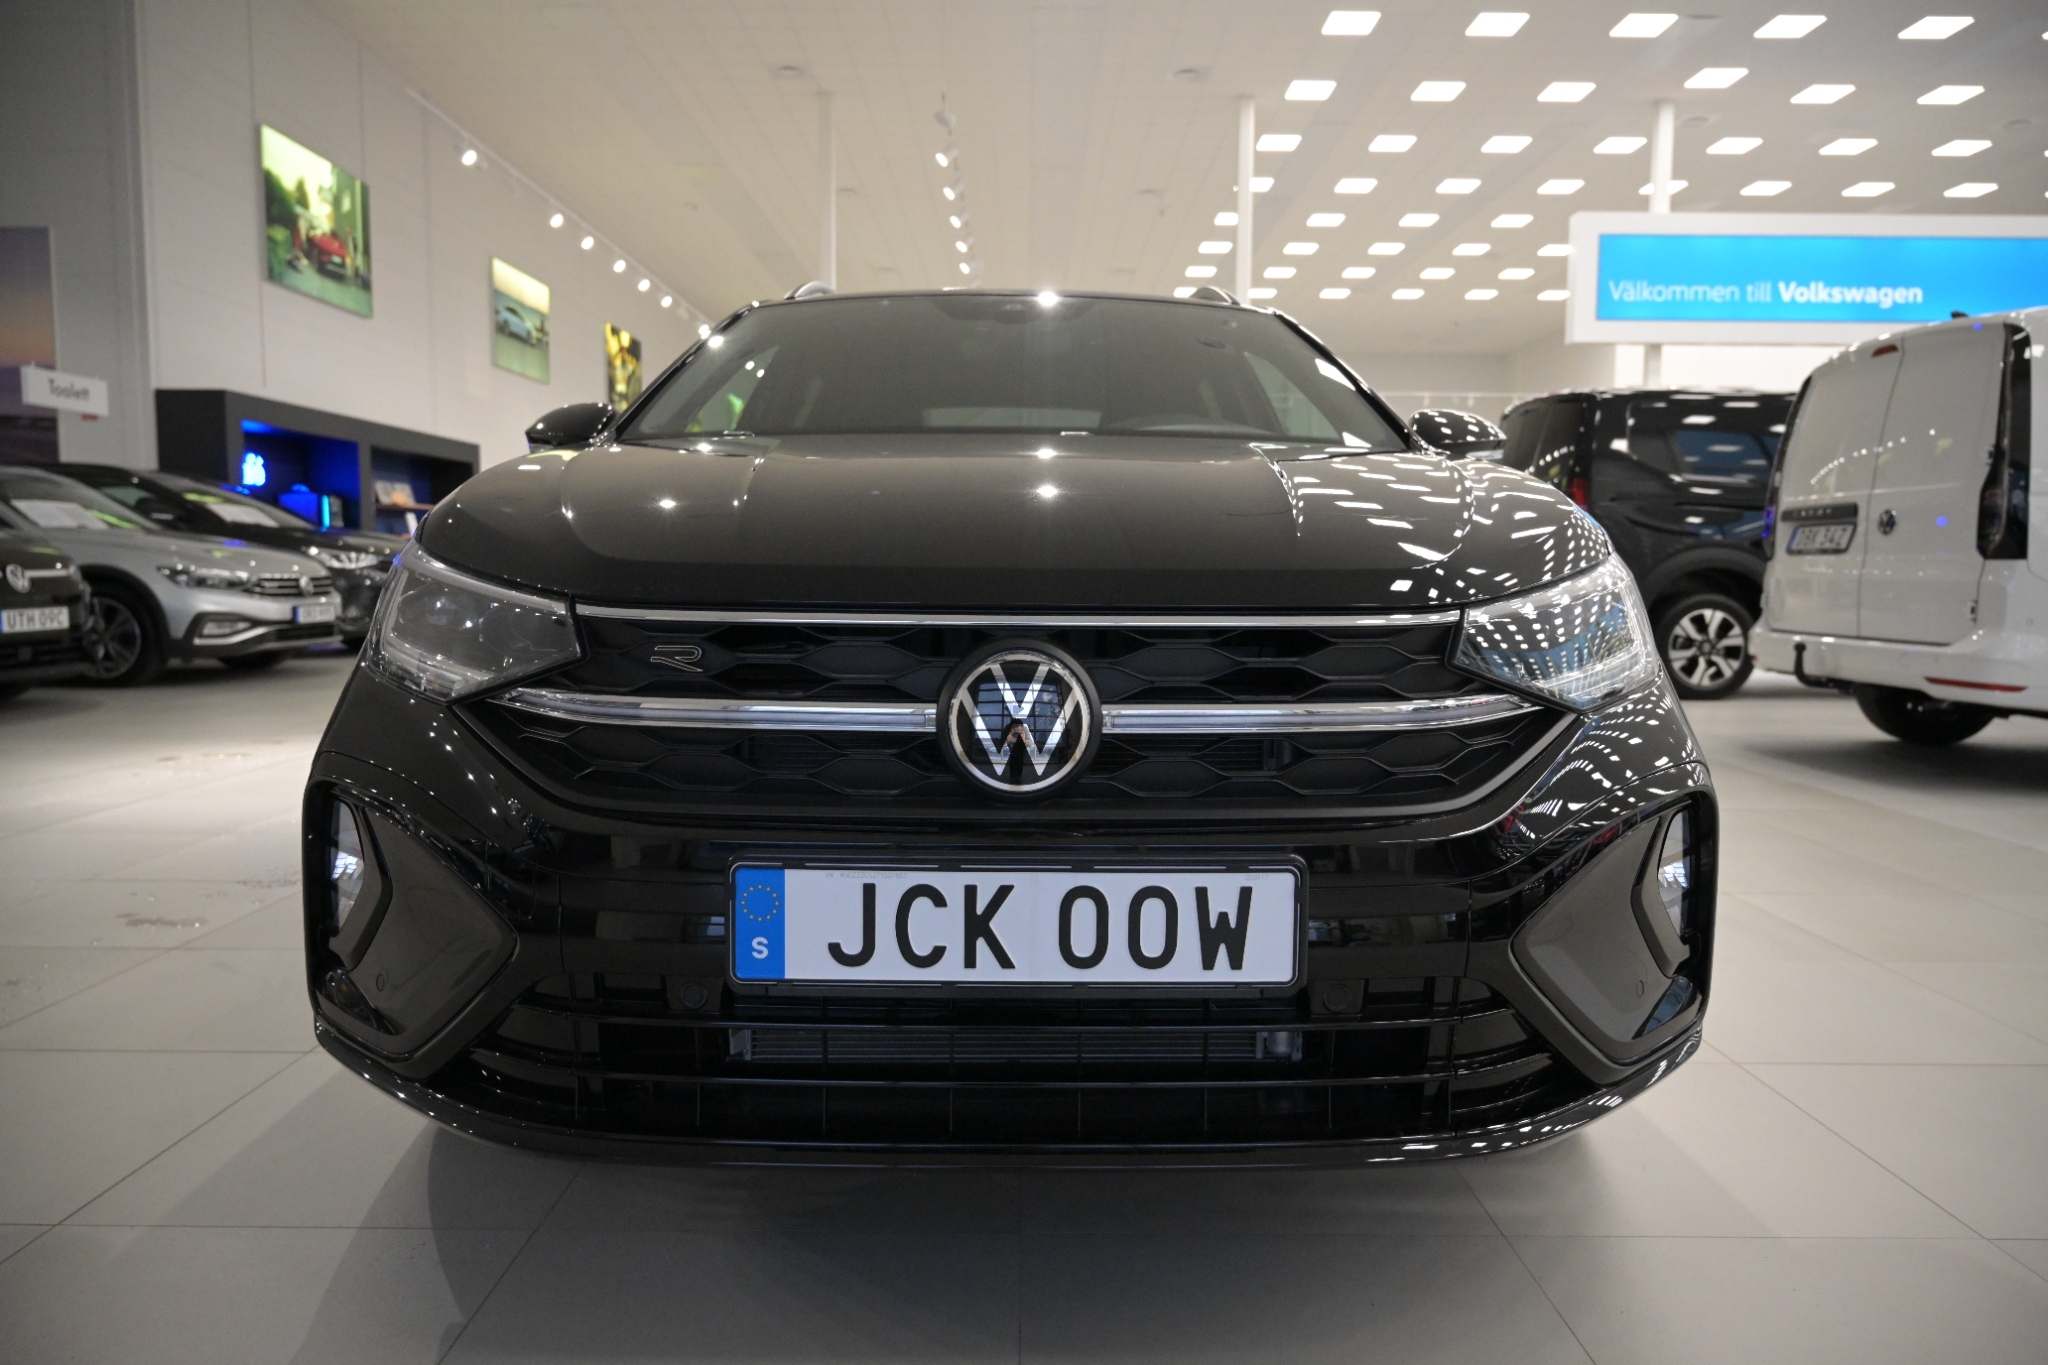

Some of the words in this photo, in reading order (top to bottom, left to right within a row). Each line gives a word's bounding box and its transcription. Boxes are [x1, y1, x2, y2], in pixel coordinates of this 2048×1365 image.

[1608, 280, 1740, 302] Välkommen
[1746, 281, 1772, 303] till
[1778, 280, 1923, 309] Volkswagen
[650, 645, 703, 673] R
[828, 883, 1016, 969] JCK
[751, 937, 769, 959] S
